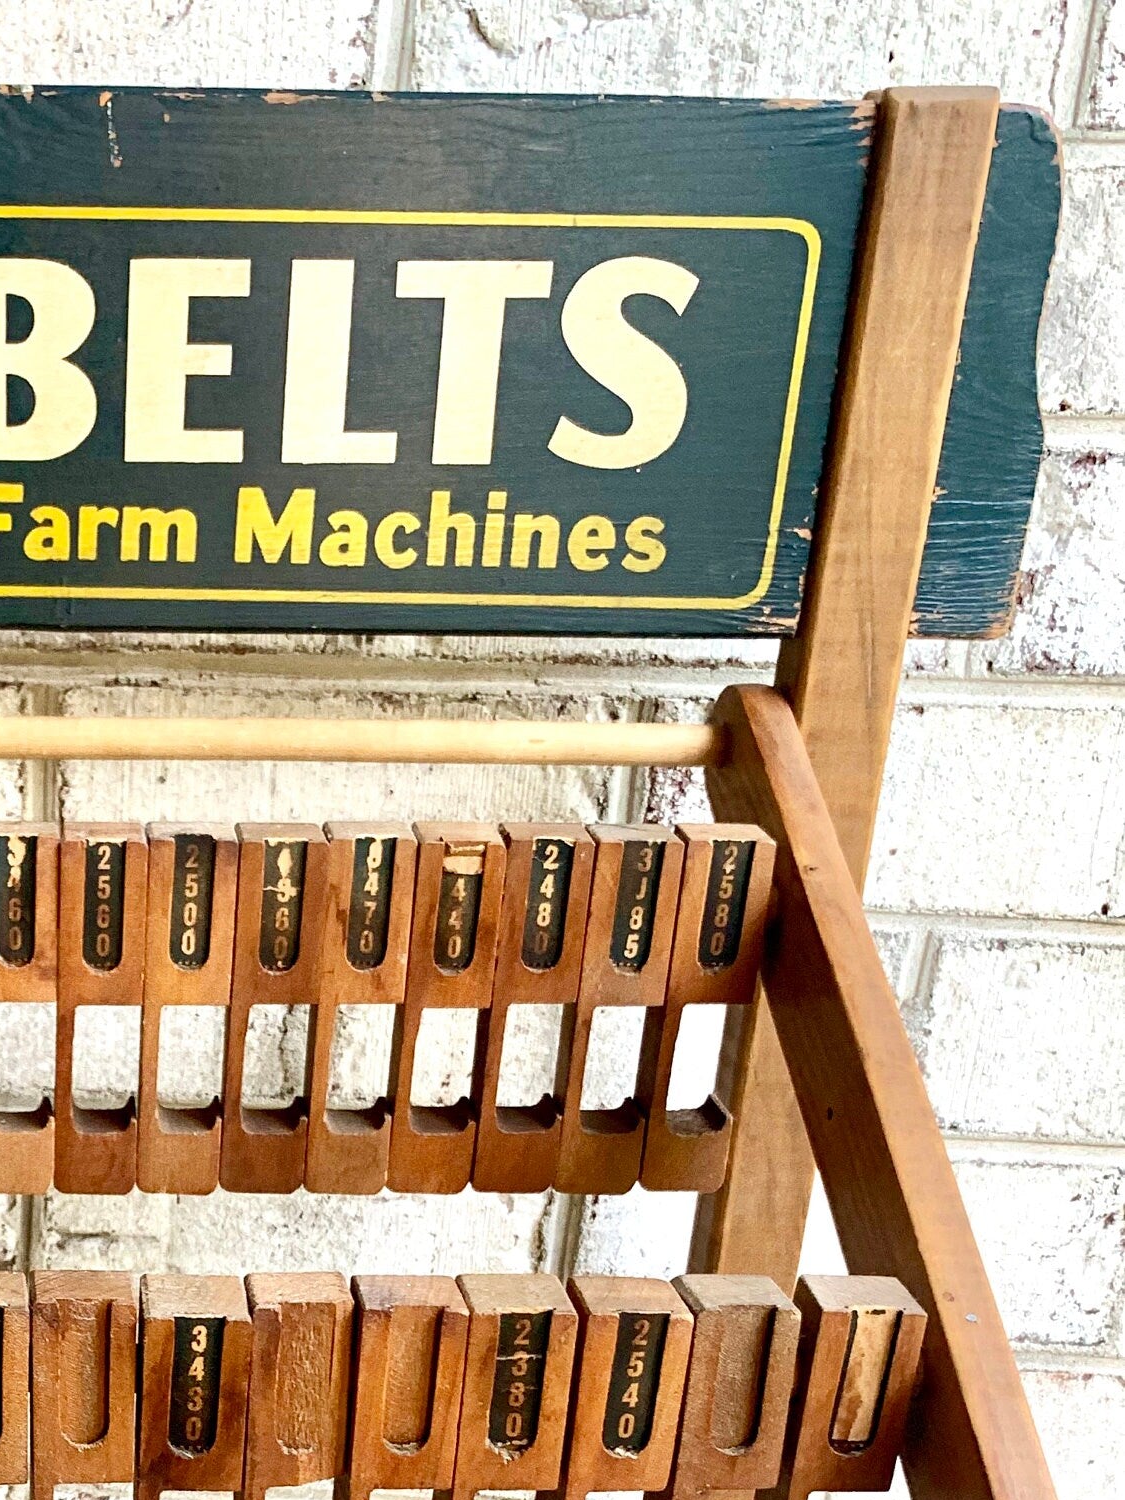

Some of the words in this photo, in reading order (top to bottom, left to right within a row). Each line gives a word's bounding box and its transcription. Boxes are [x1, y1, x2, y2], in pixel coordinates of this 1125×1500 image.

[233, 486, 668, 573] Machines
[96, 844, 112, 958] 2560
[180, 844, 200, 956] 2500
[533, 843, 560, 954] 2480
[709, 844, 738, 957] 2580
[185, 1324, 209, 1442] 3430
[505, 1318, 533, 1438] 2380
[617, 1318, 651, 1440] 2540
